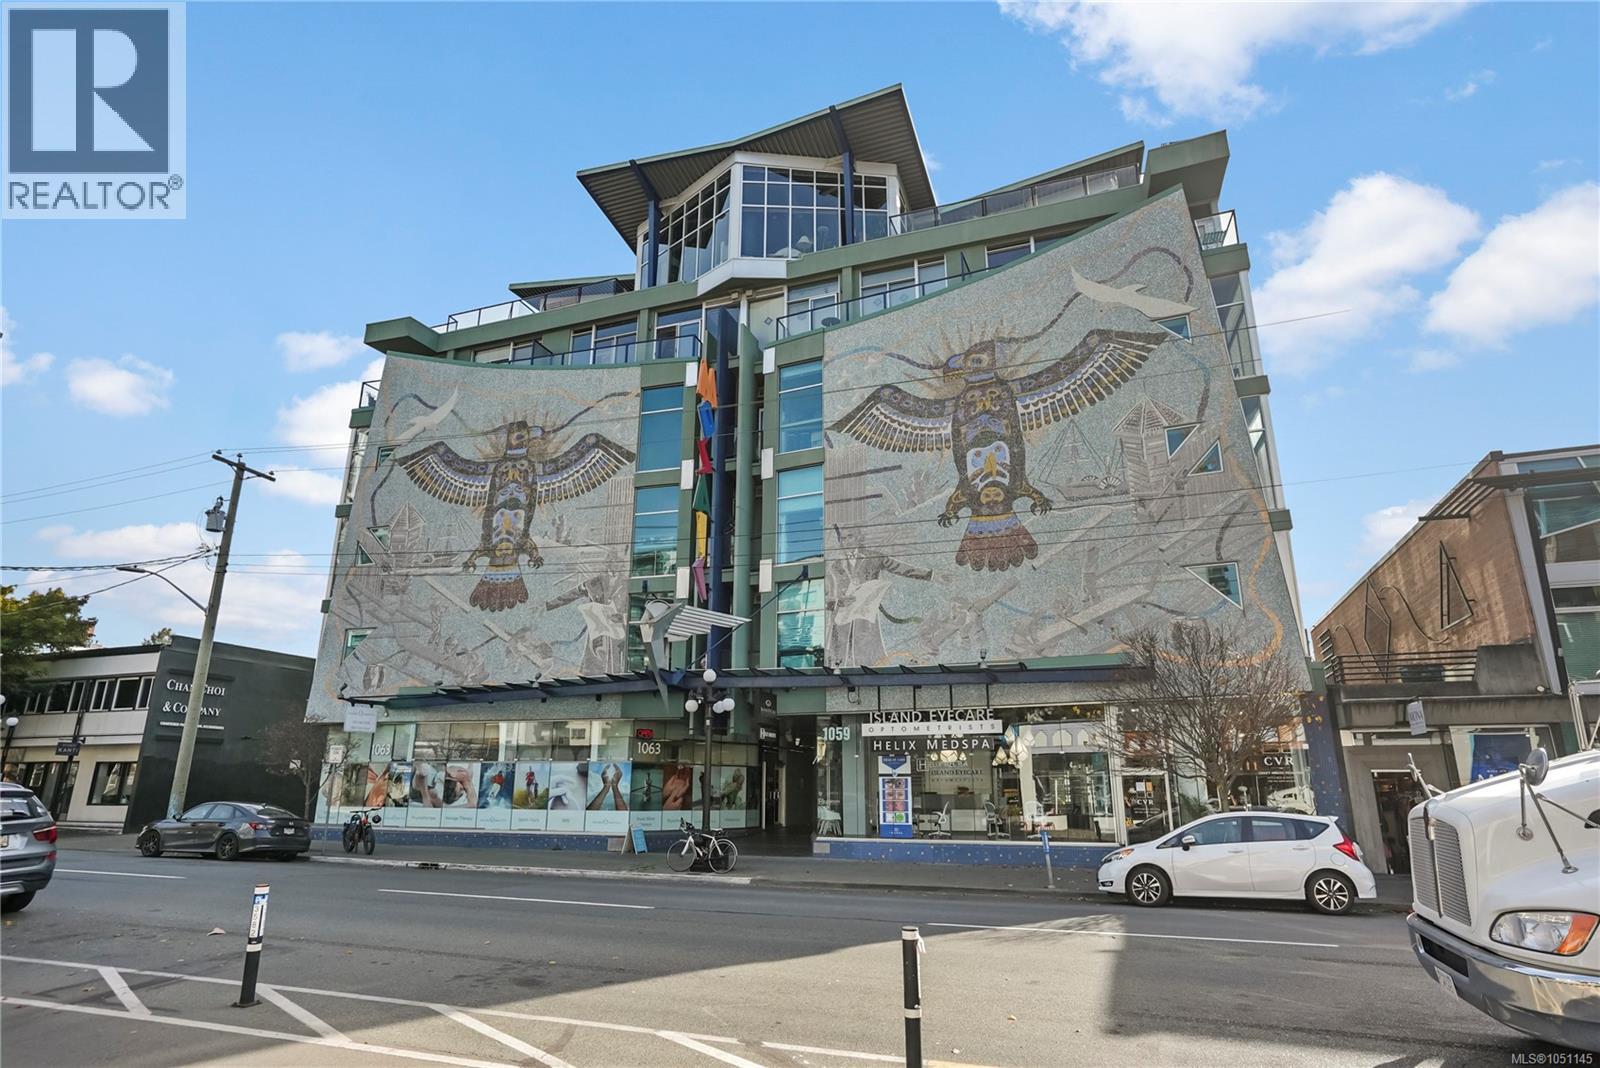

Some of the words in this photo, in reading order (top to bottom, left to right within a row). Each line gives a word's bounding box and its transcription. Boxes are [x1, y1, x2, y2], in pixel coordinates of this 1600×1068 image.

[203, 684, 226, 696] HOI
[162, 701, 172, 712] &
[869, 711, 922, 724] ISLAND
[929, 709, 995, 721] EYECARE
[822, 726, 850, 741] 1059
[868, 724, 996, 733] OPTOMETRISTS
[372, 743, 391, 756] 1063
[638, 742, 661, 755] 1063
[873, 740, 917, 751] HELIX
[927, 739, 990, 750] MEDSPA
[1263, 756, 1294, 766] CVR
